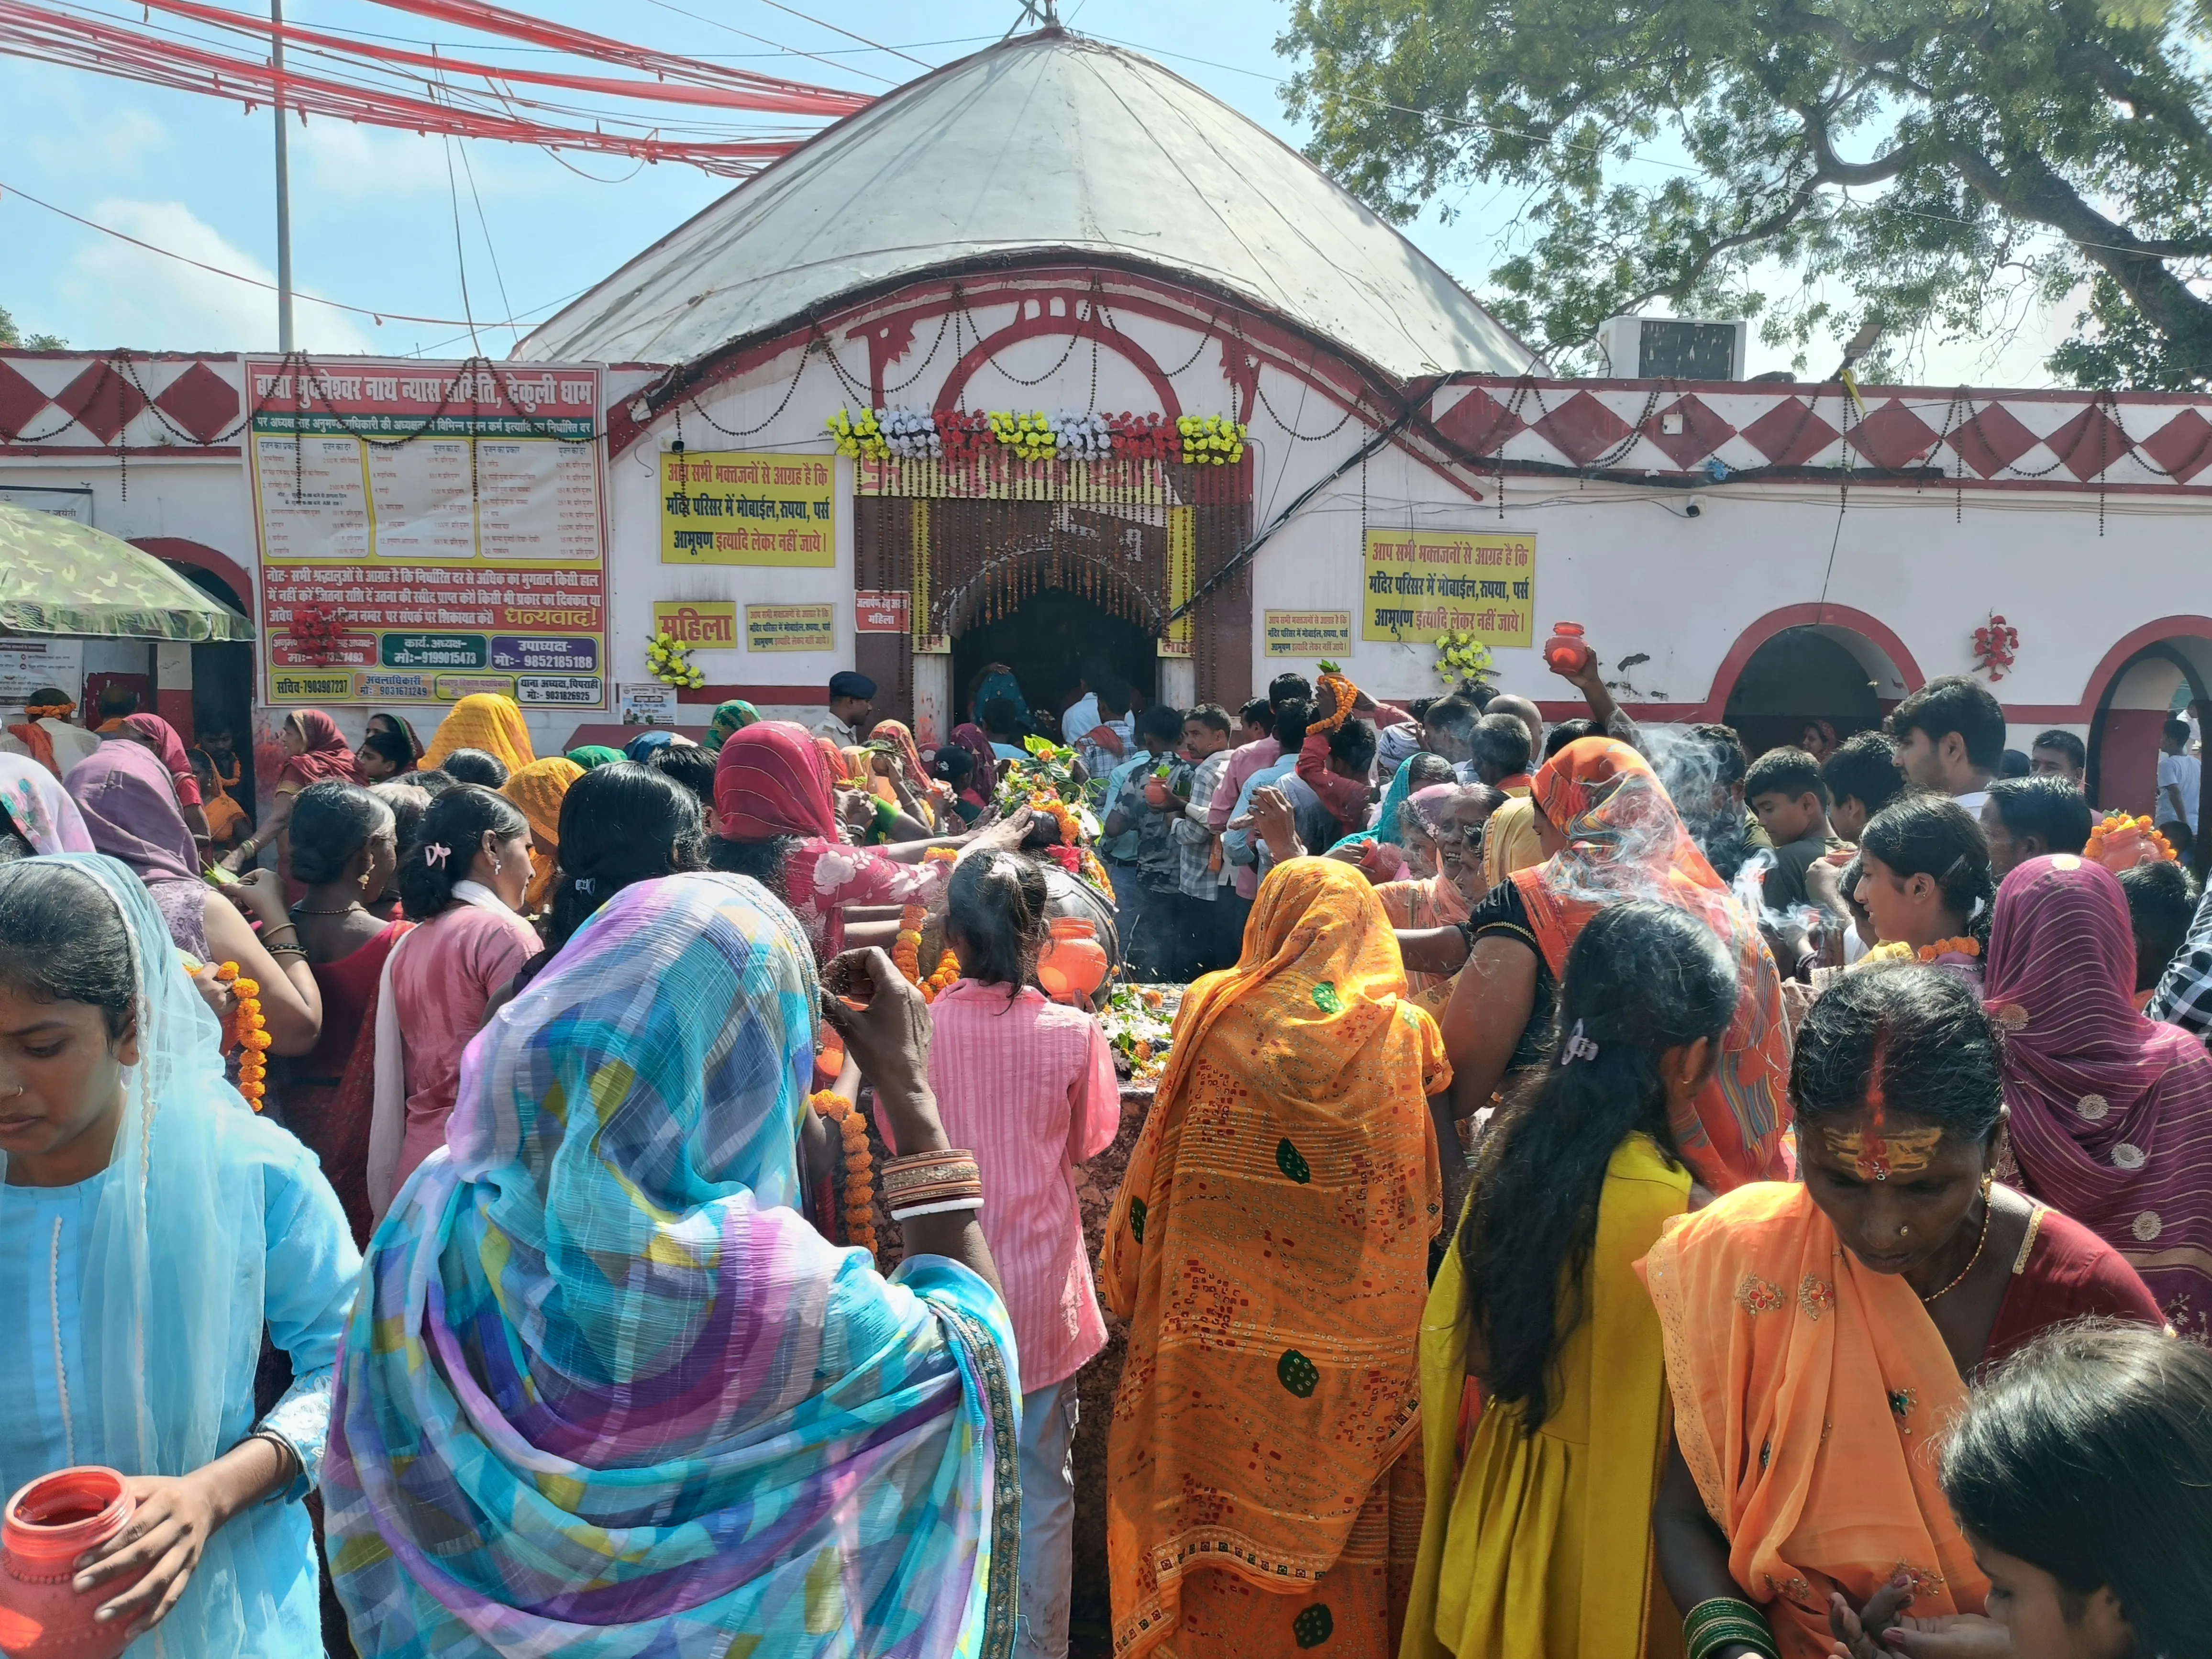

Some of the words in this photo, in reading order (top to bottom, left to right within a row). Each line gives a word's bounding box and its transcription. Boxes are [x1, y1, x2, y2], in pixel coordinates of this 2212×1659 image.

[364, 377, 398, 401] नाथ
[400, 377, 442, 403] न्यास
[506, 373, 557, 412] देकुली
[561, 380, 593, 405] धाम
[257, 417, 267, 427] पर
[380, 416, 391, 430] की
[437, 418, 464, 431] विभिन्न
[487, 418, 502, 432] कर्म
[546, 420, 577, 433] निर्धारित
[579, 422, 591, 433] दर
[668, 463, 689, 482] आप
[692, 460, 713, 483] सभी
[716, 461, 760, 485] भक्तजनों
[762, 463, 771, 485] से
[774, 466, 803, 486] आग्रह
[804, 463, 812, 486] है
[814, 463, 829, 487] कि
[666, 492, 690, 518] मंदिर
[693, 493, 722, 517] परिसर
[726, 493, 735, 517] में
[813, 496, 830, 520] पर्स
[674, 531, 713, 554] आभूषण
[716, 528, 749, 551] इत्यादि
[751, 529, 776, 552] लेकर
[778, 529, 798, 553] नहीं
[1372, 542, 1393, 561] आप
[1396, 540, 1415, 562] सभी
[1419, 541, 1461, 564] भक्तजनों
[1463, 542, 1472, 564] से
[1475, 546, 1502, 566] आग्रह
[1505, 543, 1513, 566] है
[1514, 543, 1529, 566] कि
[291, 567, 311, 582] सभी
[355, 567, 363, 582] से
[366, 570, 390, 583] आग्रह
[391, 568, 399, 583] है
[401, 568, 413, 583] कि
[416, 568, 450, 583] निर्धारित
[453, 572, 464, 584] दर
[465, 569, 474, 585] से
[477, 570, 505, 585] अधिक
[506, 573, 520, 586] का
[554, 570, 579, 587] किसी
[580, 574, 599, 587] हाल
[1369, 570, 1393, 594] मंदिर
[1395, 572, 1424, 596] परिसर
[1427, 573, 1436, 596] में
[1513, 576, 1529, 600] पर्स
[267, 587, 277, 602] में
[278, 587, 297, 602] नहीं
[375, 590, 397, 603] उतना
[398, 588, 412, 603] की
[477, 591, 502, 605] किसी
[503, 591, 517, 605] भी
[517, 594, 541, 606] प्रकार
[542, 594, 555, 606] का
[856, 596, 881, 608] जलार्पण
[881, 596, 891, 612] हेतु
[386, 610, 397, 622] पर
[425, 611, 436, 623] पर
[504, 608, 597, 627] धन्यवाद!
[659, 608, 733, 642] महिला
[868, 612, 895, 624] महिला
[1375, 608, 1413, 633] आभूषण
[1416, 606, 1448, 630] इत्यादि
[1450, 607, 1474, 630] लेकर
[1477, 608, 1496, 630] नहीं
[524, 655, 592, 668] 9852185188
[380, 686, 427, 696] 9031671249
[545, 691, 590, 700] 9031826925
